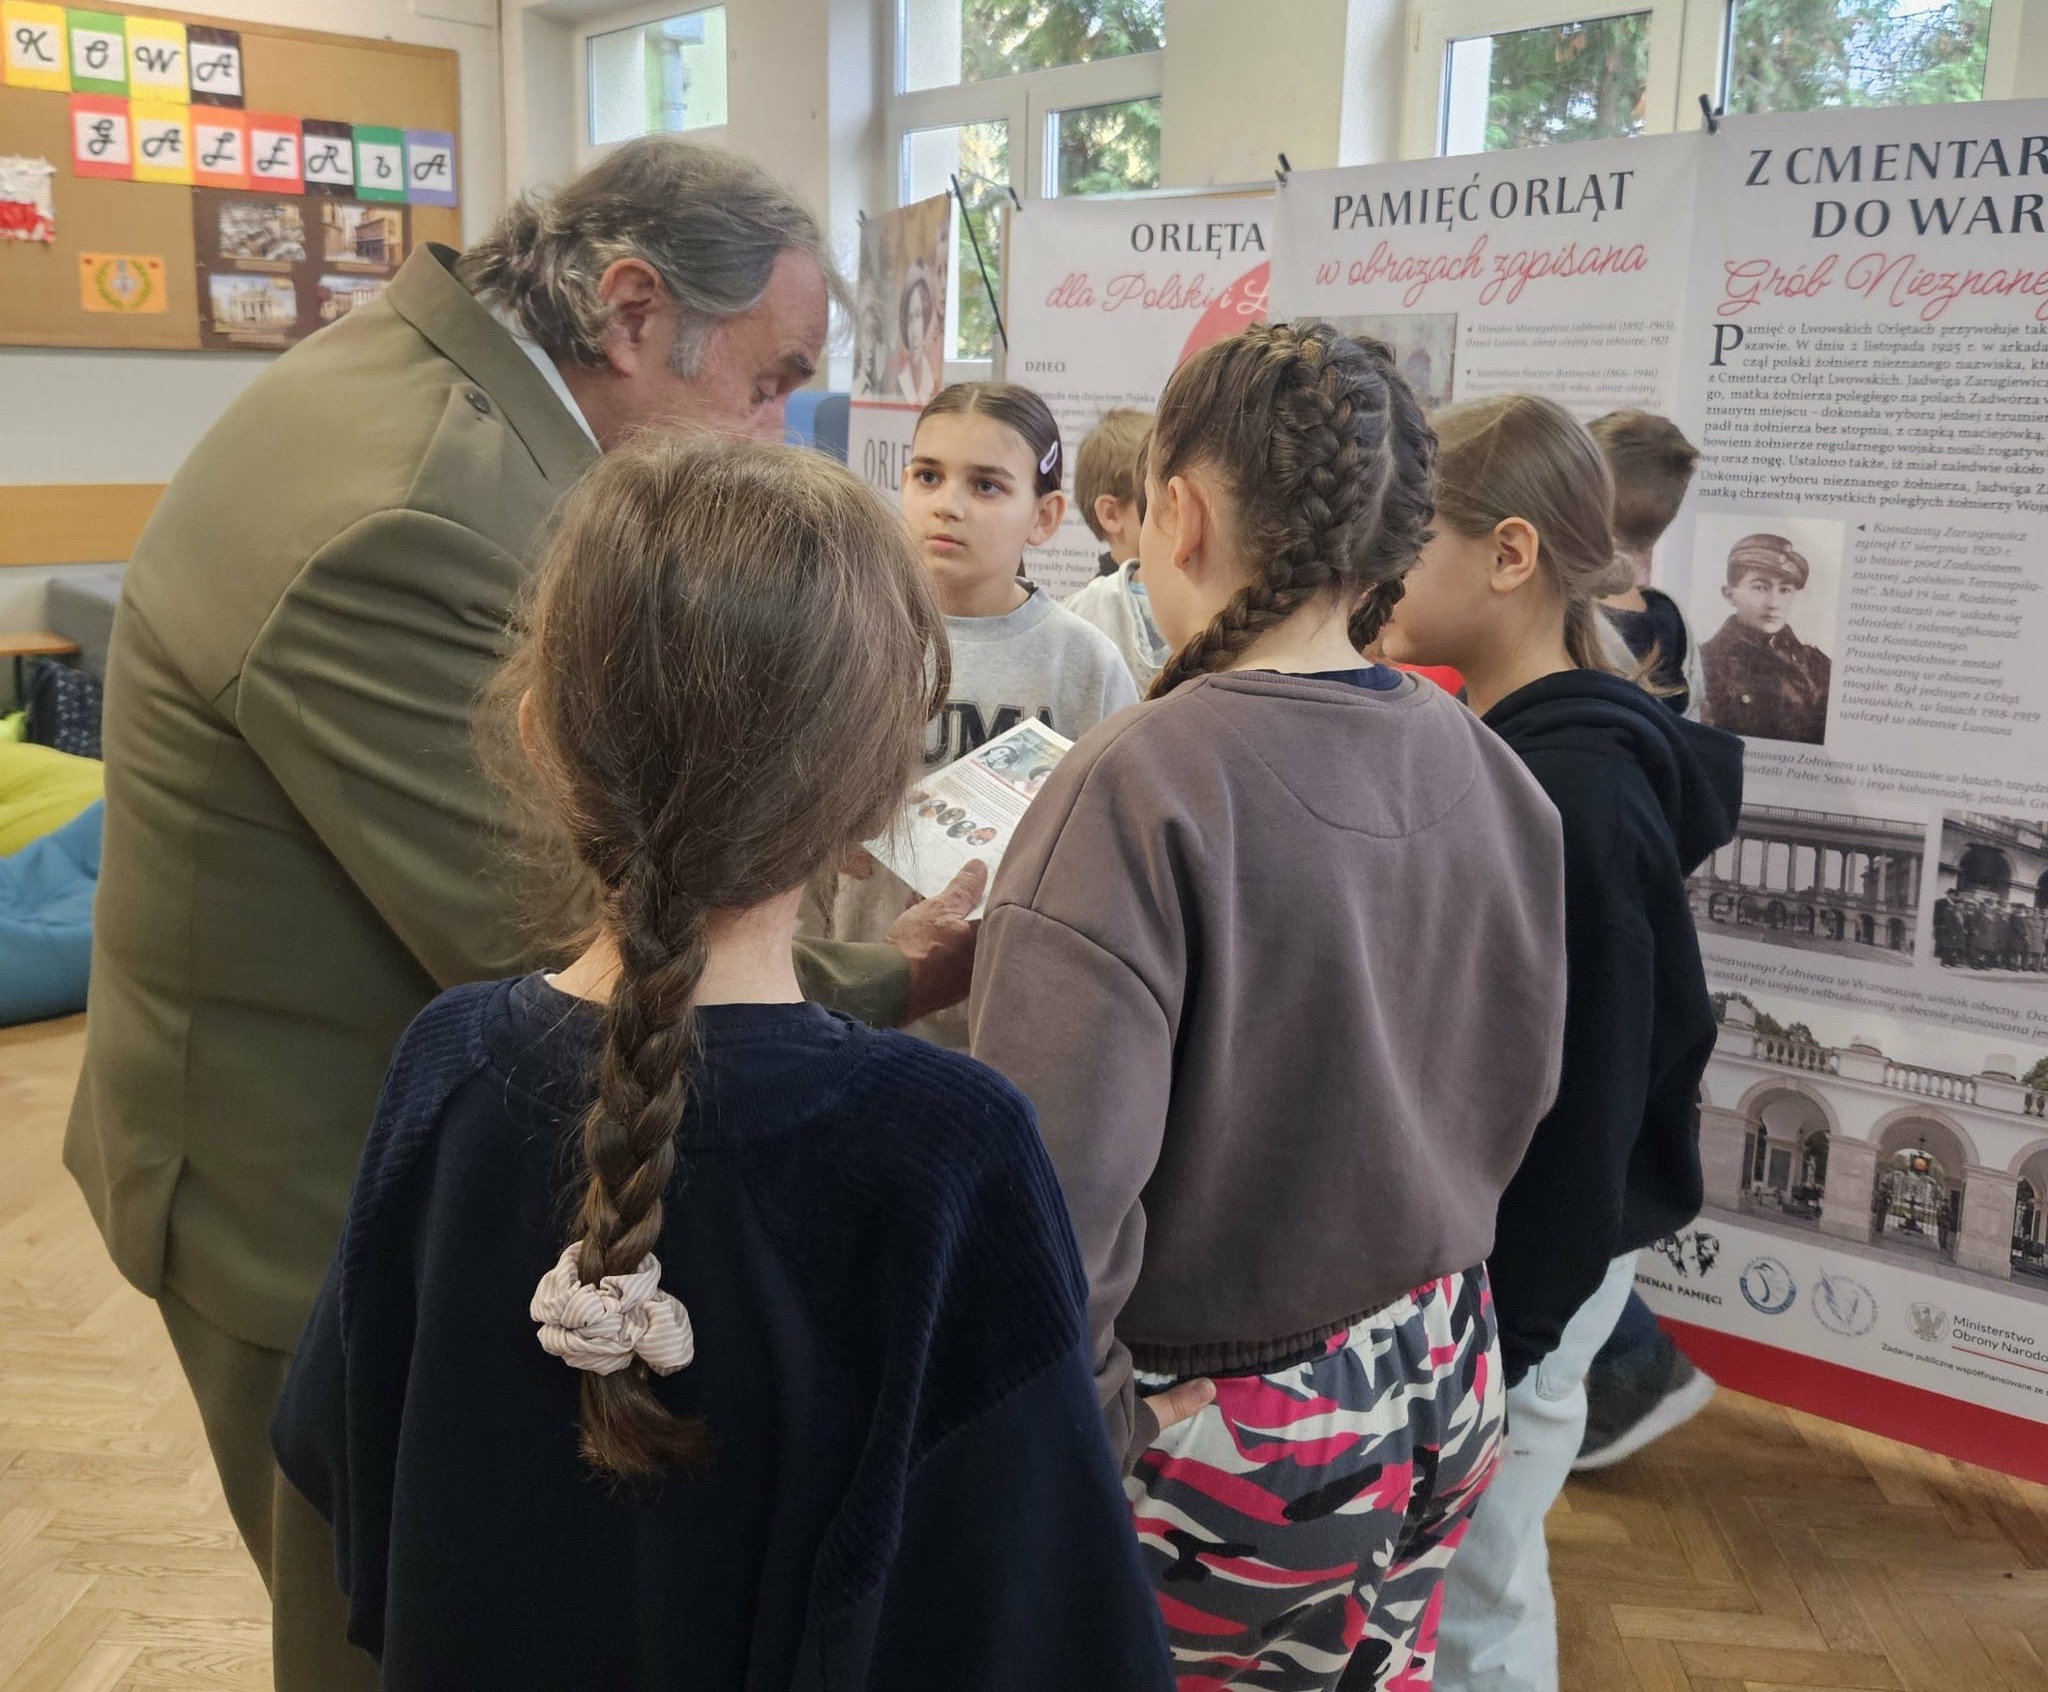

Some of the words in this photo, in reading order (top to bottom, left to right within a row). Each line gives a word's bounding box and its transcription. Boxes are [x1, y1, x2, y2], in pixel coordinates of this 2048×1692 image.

[1745, 149, 1773, 186] Z
[1332, 173, 1480, 232] PAMIĘĆ
[1490, 171, 1634, 222] ORLĄT
[1811, 200, 1890, 238] DO
[1907, 194, 2046, 235] WAR
[1130, 223, 1266, 260] ORLĘTA
[1347, 234, 1483, 307] obrazach
[1478, 242, 1648, 306] zapisana
[1717, 254, 1839, 316] Grób
[1046, 273, 1095, 308] dla
[1102, 272, 1214, 312] Polski
[1025, 362, 1066, 372] DZIECI
[1772, 357, 1810, 370] polski
[1677, 1286, 1723, 1306] PAMIĘCI
[1953, 1315, 2035, 1345] Ministerstwo
[1953, 1329, 1999, 1350] Obrony
